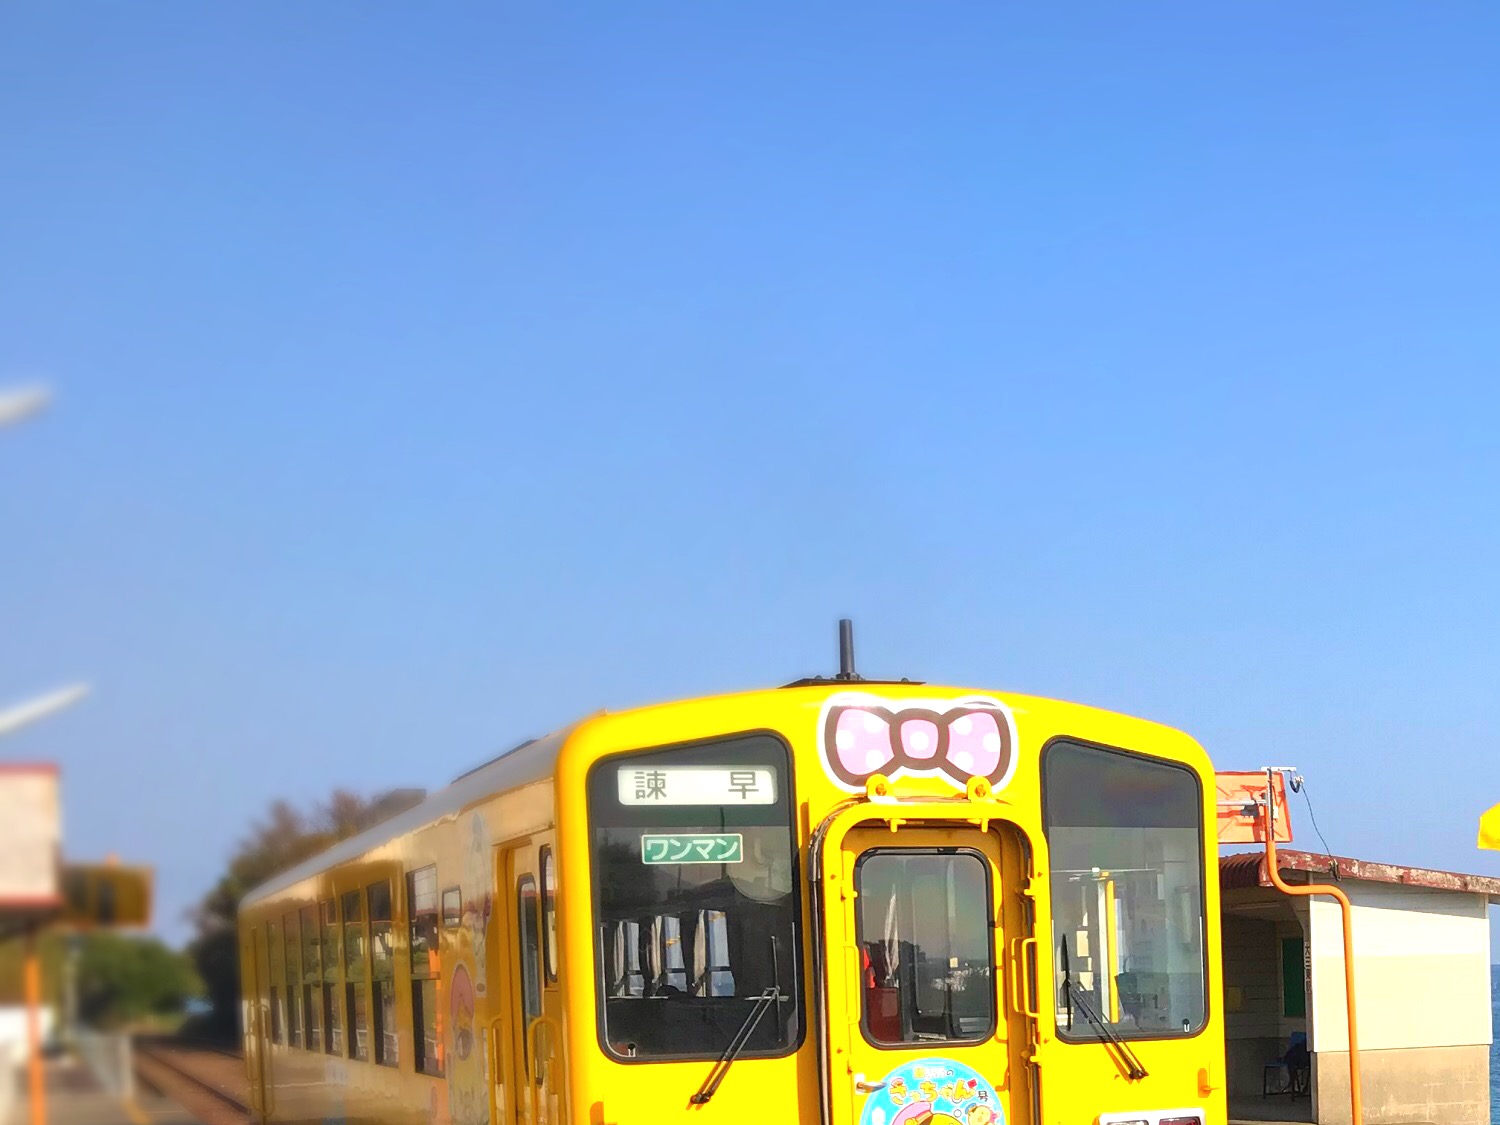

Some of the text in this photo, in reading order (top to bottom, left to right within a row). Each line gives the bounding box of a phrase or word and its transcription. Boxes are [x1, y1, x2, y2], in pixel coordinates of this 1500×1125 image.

[634, 771, 759, 799] 諫早
[646, 838, 738, 860] ワンマン
